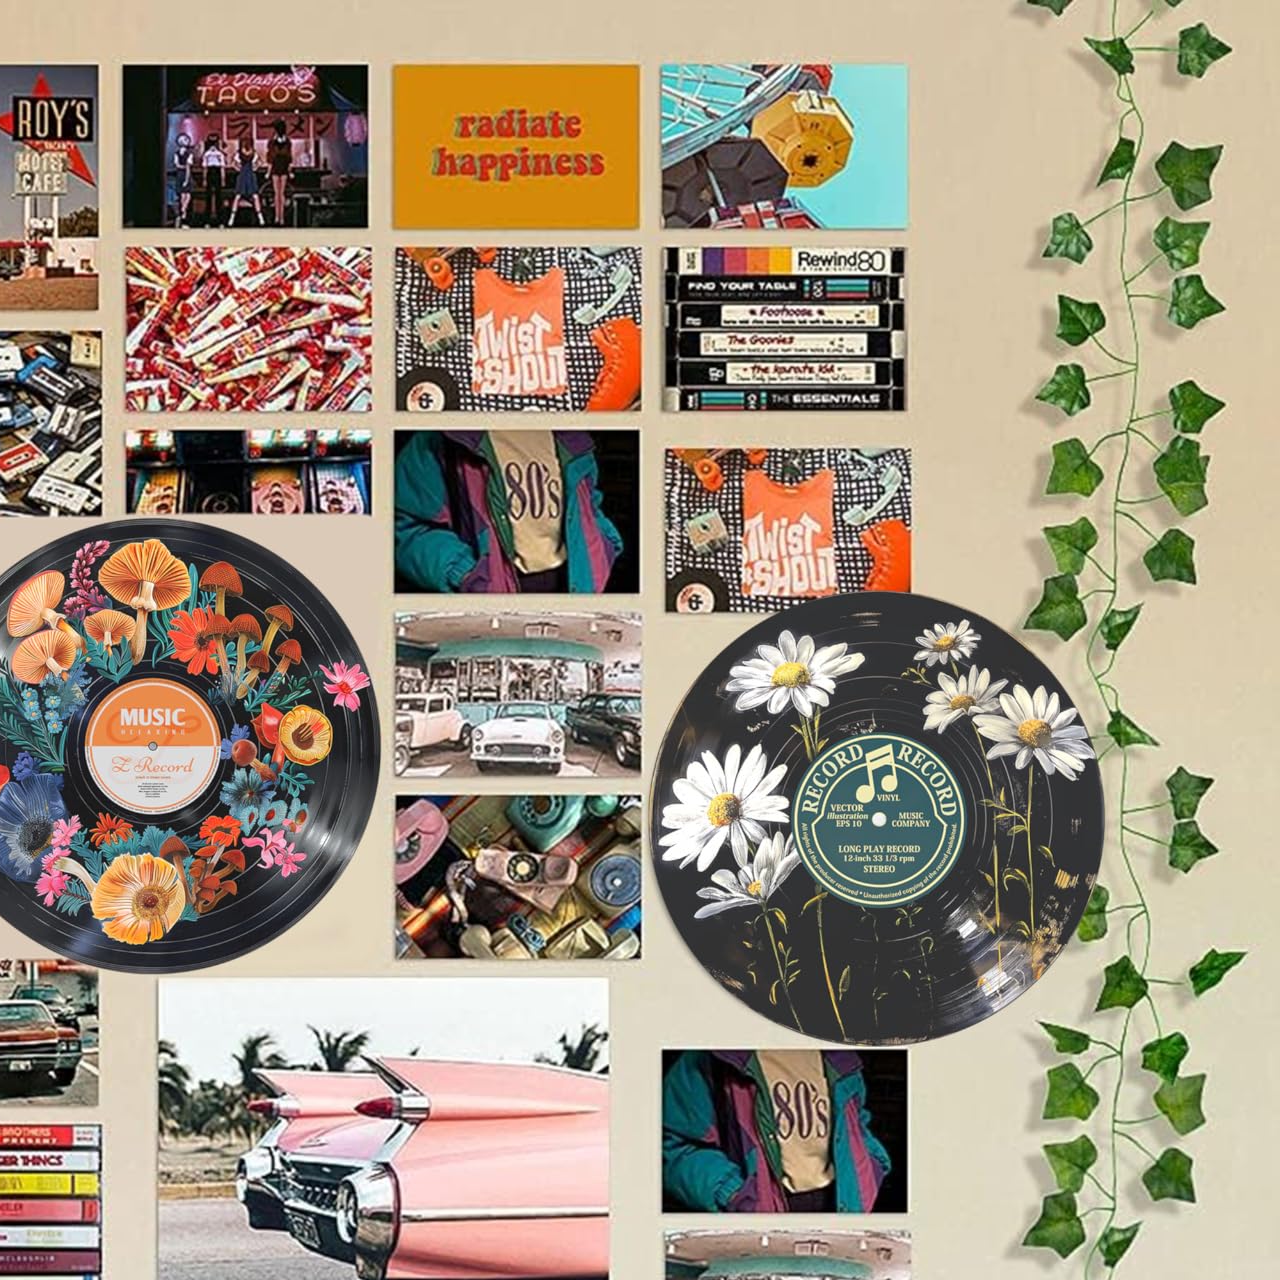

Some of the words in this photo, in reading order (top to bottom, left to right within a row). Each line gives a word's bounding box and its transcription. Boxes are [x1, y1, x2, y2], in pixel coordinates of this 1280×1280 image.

[18, 99, 89, 138] ROY'S
[454, 109, 582, 138] radiate
[432, 147, 606, 182] happiness
[22, 173, 62, 191] CAFE
[504, 460, 561, 520] 80's
[120, 708, 186, 727] MUSIC
[134, 756, 195, 773] Record
[801, 743, 864, 815] RECORD
[896, 743, 958, 816] RECORD
[876, 794, 902, 802] VINYL
[830, 804, 864, 812] VECTOR
[826, 812, 869, 820] illustration
[898, 812, 924, 820] MUSIC
[836, 820, 851, 828] EPS
[852, 820, 863, 828] 10
[891, 820, 931, 828] COMPANY
[838, 845, 862, 854] LONG
[863, 845, 885, 854] PLAY
[886, 845, 921, 854] RECORD
[844, 854, 872, 862] 12-inch
[872, 854, 883, 862] 33
[898, 856, 915, 864] rpm
[864, 864, 896, 874] STEREO
[773, 1080, 829, 1140] 80's
[20, 1154, 64, 1166] THINGS
